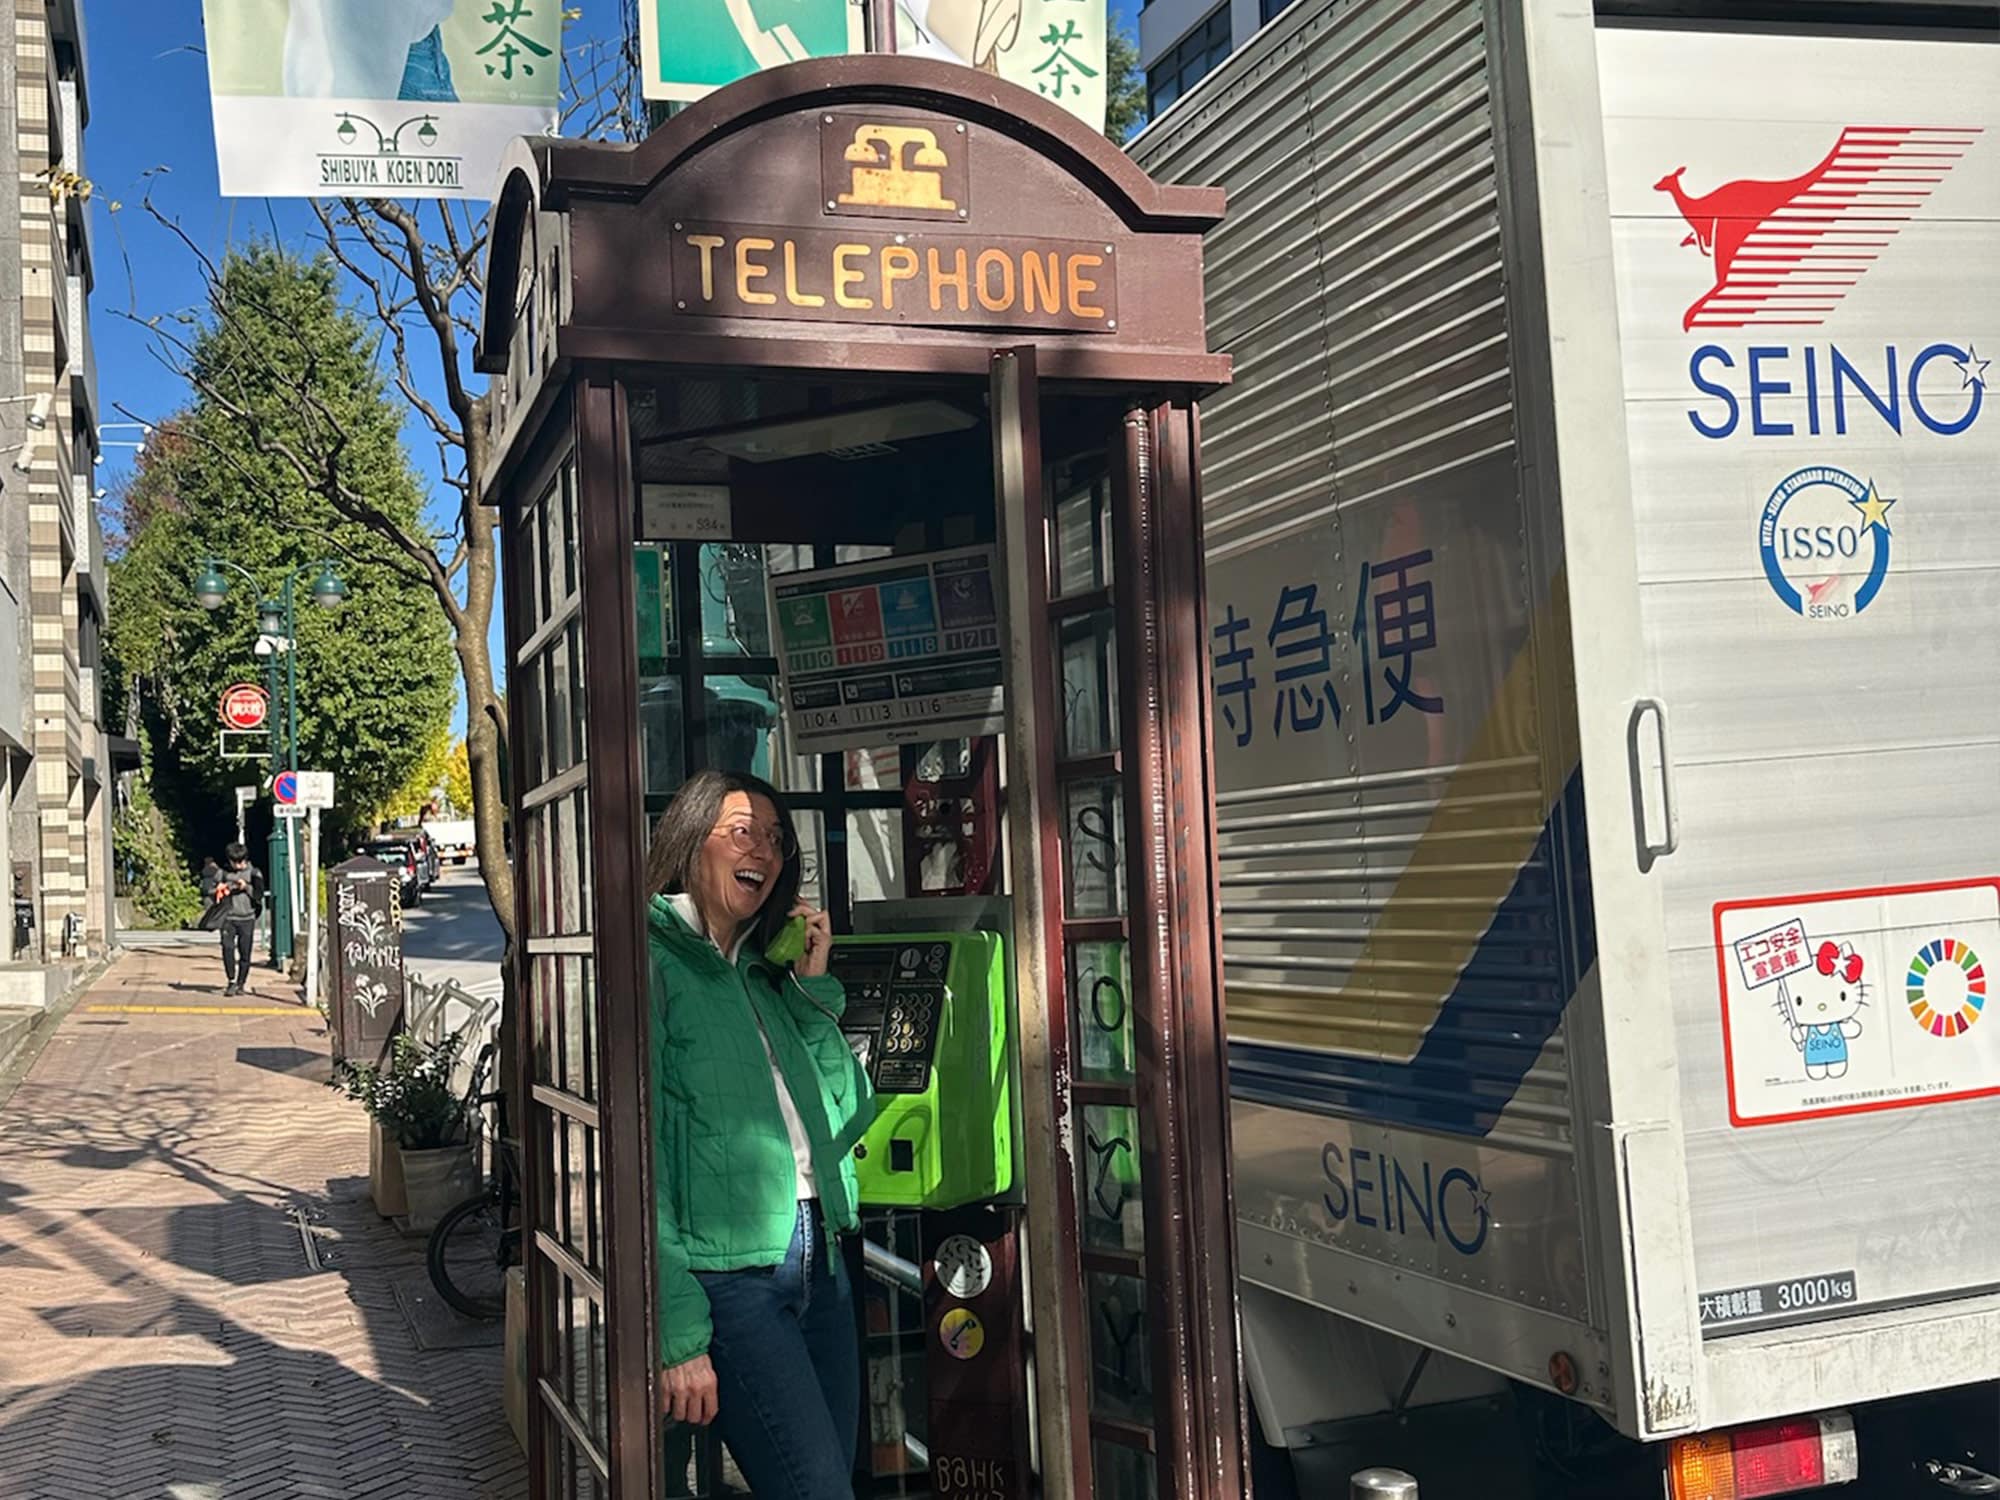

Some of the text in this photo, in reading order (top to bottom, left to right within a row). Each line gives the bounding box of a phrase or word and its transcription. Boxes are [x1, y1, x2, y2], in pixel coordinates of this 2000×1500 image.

[321, 156, 459, 185] SHIBUYA KOEN DORI
[686, 235, 1105, 318] TELEPHONE
[1687, 343, 1990, 438] SEINO
[1780, 525, 1857, 561] ISSO
[1809, 604, 1849, 618] SEINO
[790, 652, 833, 669] 110
[839, 644, 884, 665] 119
[890, 638, 938, 658] 118
[948, 628, 996, 650] 171
[1211, 549, 1444, 748] 特急便
[803, 712, 838, 728] 104
[855, 705, 891, 721] 113
[905, 699, 941, 716] 116
[1740, 927, 1803, 963] エコ安全
[1752, 949, 1800, 981] 宣言車
[1809, 1038, 1842, 1051] SEINO
[1322, 1142, 1491, 1256] SEINO
[1778, 1279, 1853, 1310] 3000kg
